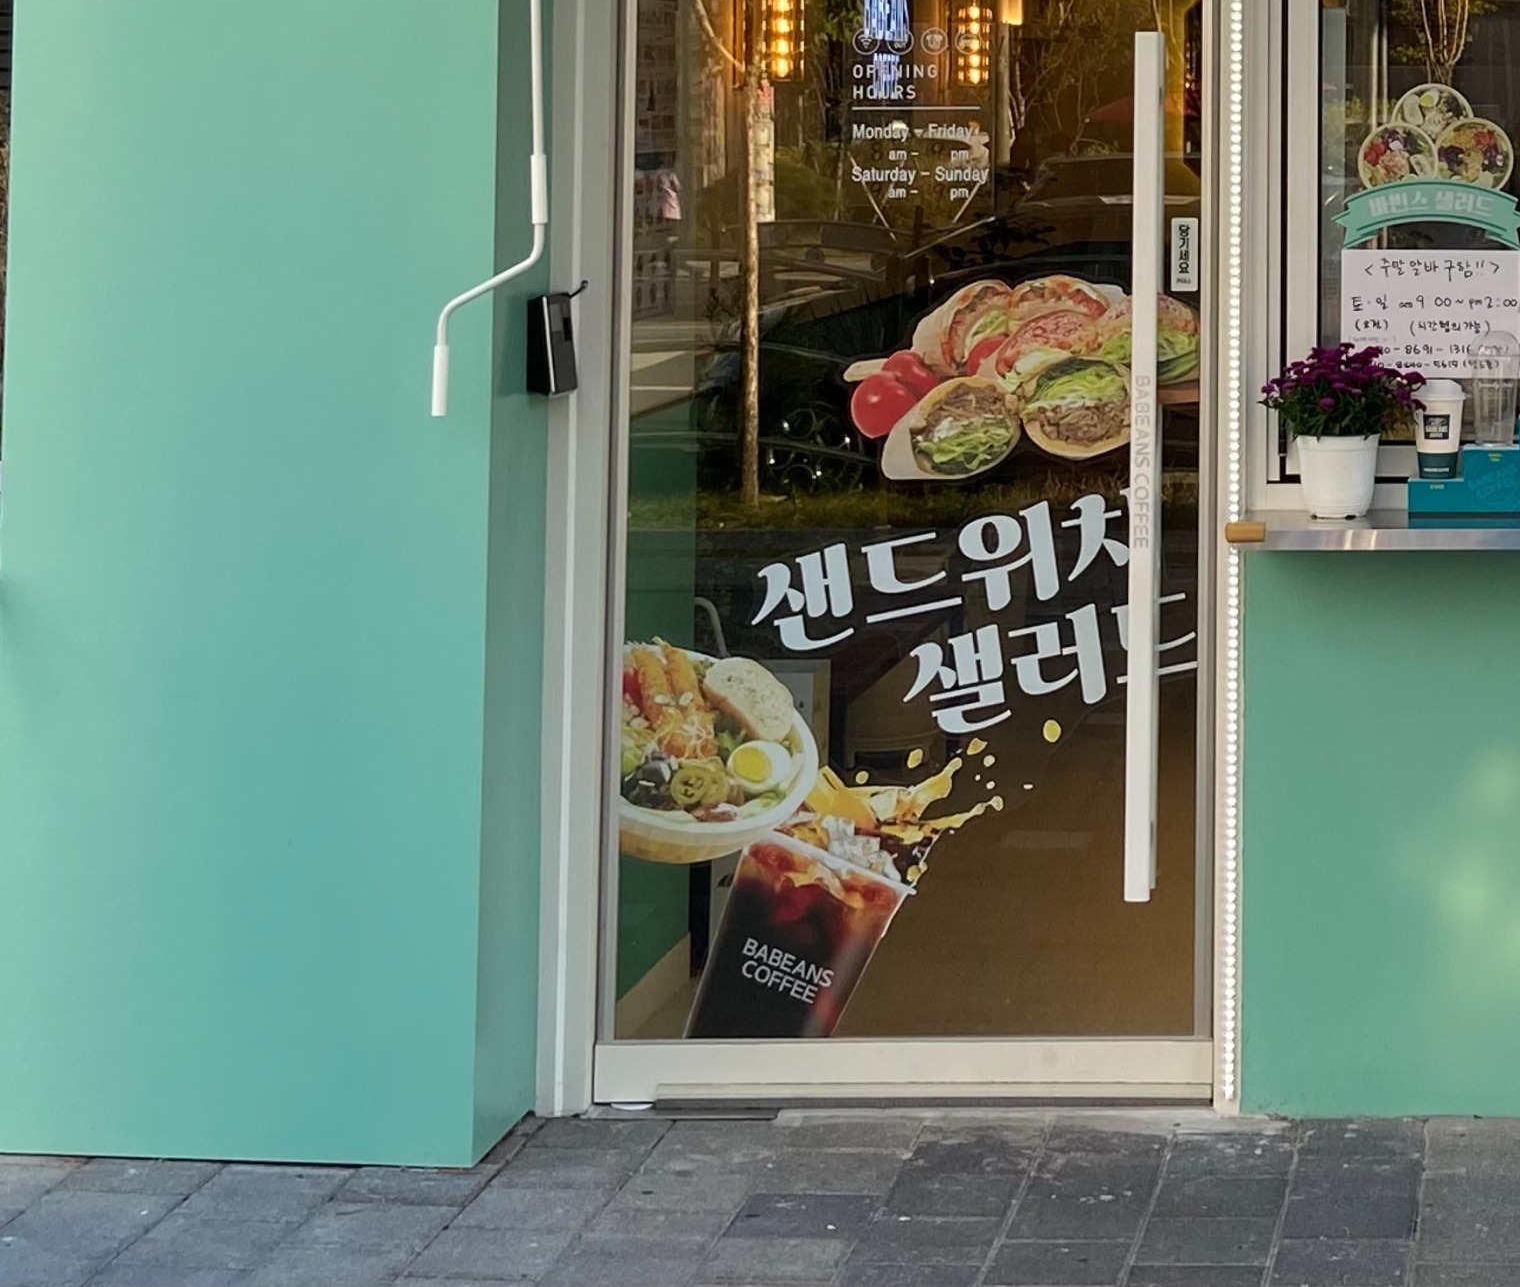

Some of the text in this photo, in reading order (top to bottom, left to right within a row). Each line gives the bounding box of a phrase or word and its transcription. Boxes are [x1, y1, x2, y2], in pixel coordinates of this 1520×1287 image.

[852, 123, 910, 143] Monday
[928, 123, 974, 143] Friday
[888, 150, 907, 161] am
[950, 149, 969, 163] pm
[851, 166, 917, 185] Saturday
[934, 166, 990, 185] Sunday
[888, 187, 906, 199] am
[950, 187, 969, 201] pm
[1368, 191, 1431, 217] 바빈스
[1178, 224, 1190, 274] 당기세요
[1410, 260, 1439, 276] 알바
[1133, 374, 1151, 549] BABEANS COFFEE
[742, 937, 834, 988] BABEANS
[741, 961, 819, 1005] COFFEE
